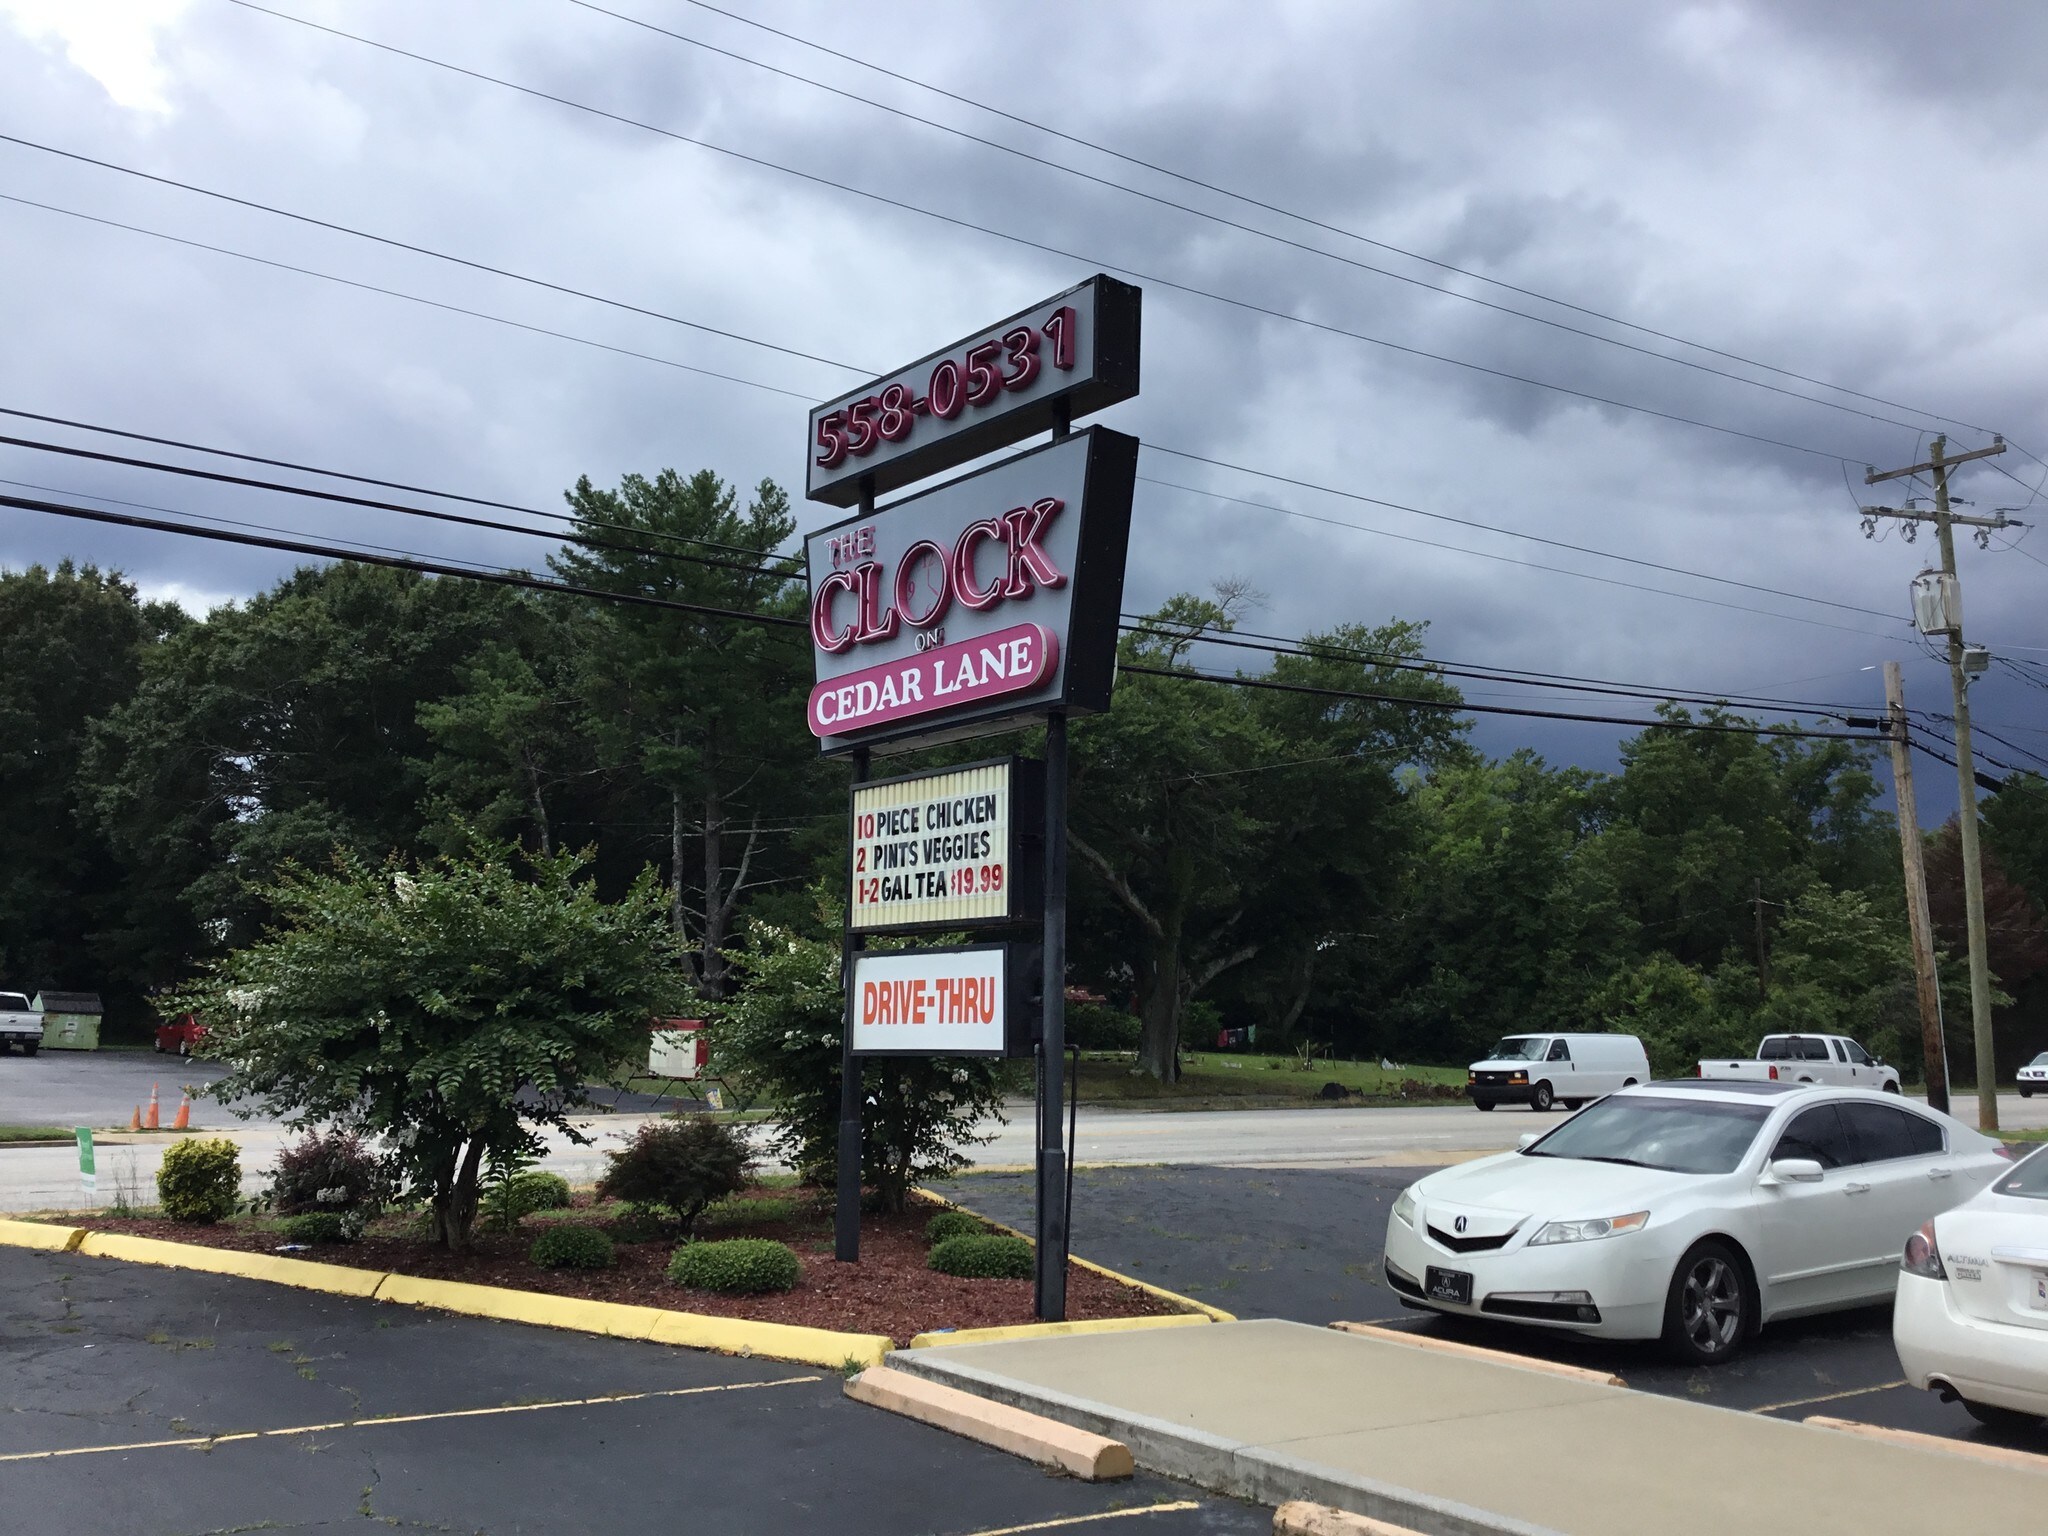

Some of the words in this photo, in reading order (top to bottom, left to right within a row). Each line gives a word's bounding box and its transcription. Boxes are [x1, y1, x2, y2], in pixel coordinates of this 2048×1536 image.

[816, 306, 1076, 469] 558-0531
[824, 525, 876, 569] THE
[812, 497, 1068, 654] CLOCK
[914, 627, 945, 651] ON
[816, 668, 923, 725] CEDAR
[933, 636, 1033, 696] LANE
[858, 813, 874, 839] 10
[877, 807, 919, 837] PIECE
[926, 794, 996, 830] CHICKEN
[857, 847, 866, 872] 2
[873, 841, 918, 870] PINTS
[923, 830, 990, 864] VEGGIES
[859, 878, 879, 904] 1-2
[881, 874, 912, 901] GAL
[915, 871, 947, 898] TEA
[951, 864, 1003, 895] $19.99
[863, 976, 995, 1025] DRIVE-THRU
[1432, 1285, 1460, 1297] ACURA
